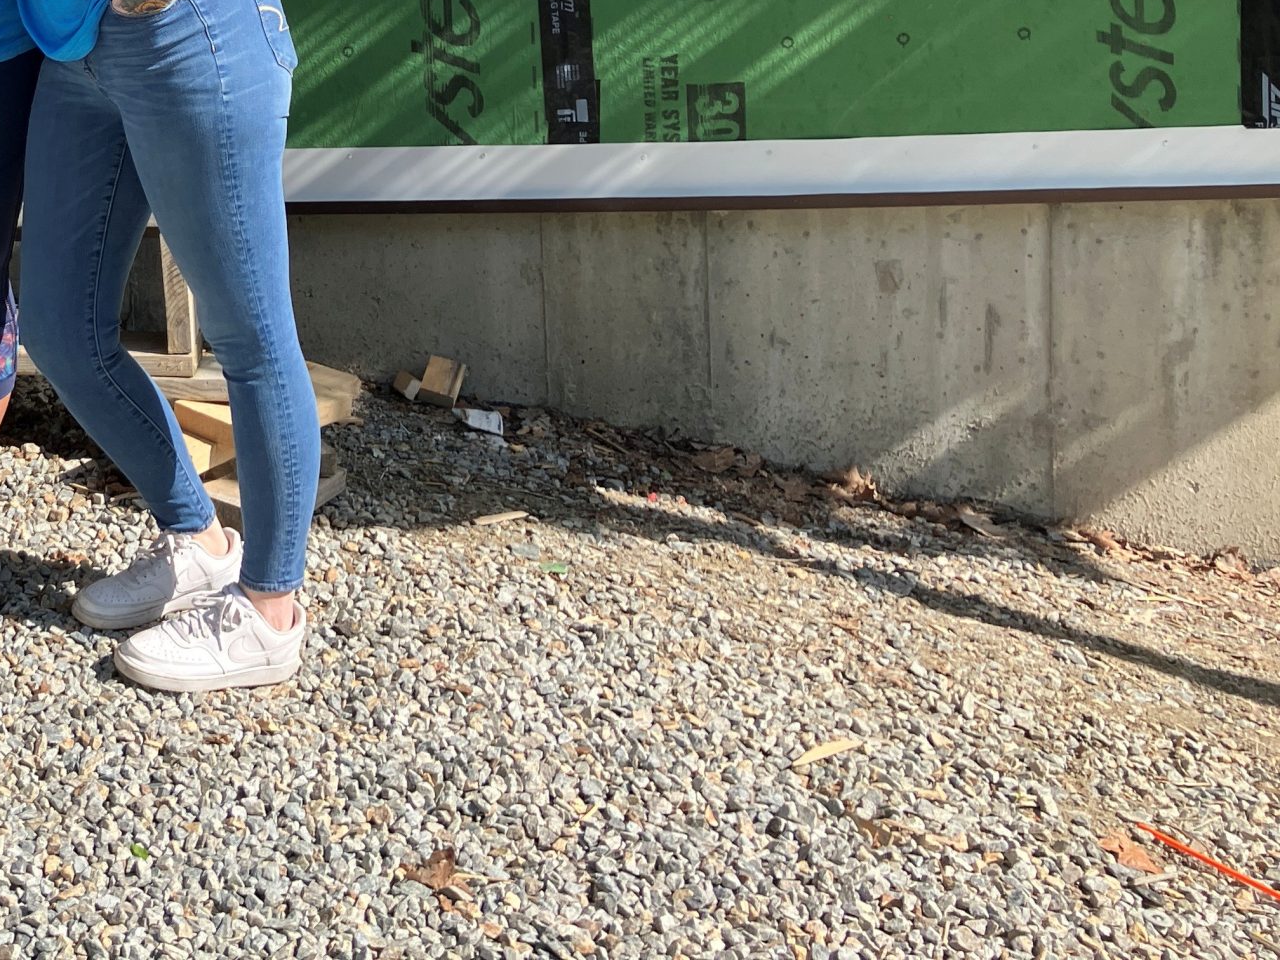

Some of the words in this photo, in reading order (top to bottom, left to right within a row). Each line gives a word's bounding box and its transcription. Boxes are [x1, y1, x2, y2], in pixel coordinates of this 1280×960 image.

[551, 11, 561, 35] TAPE
[642, 57, 656, 108] LIMITED
[660, 53, 679, 101] YEAR
